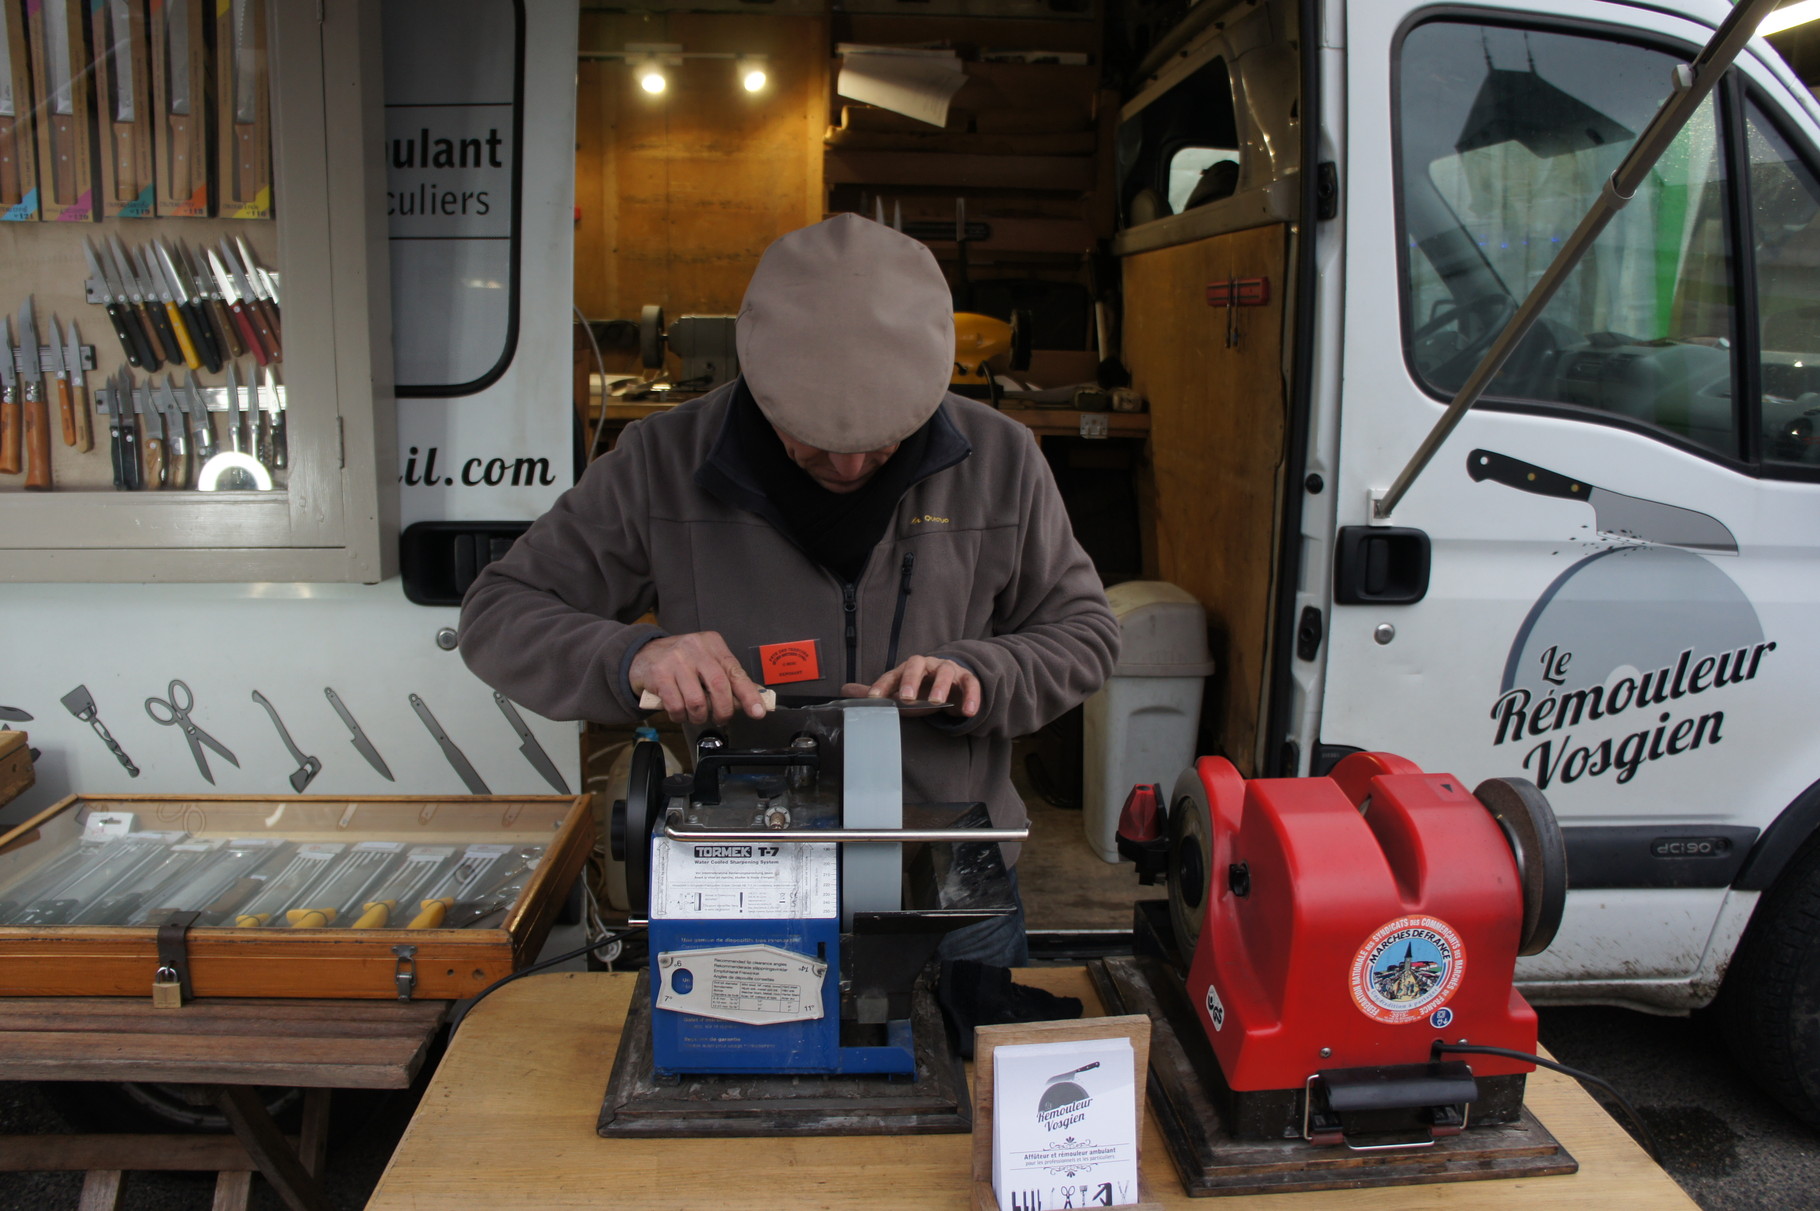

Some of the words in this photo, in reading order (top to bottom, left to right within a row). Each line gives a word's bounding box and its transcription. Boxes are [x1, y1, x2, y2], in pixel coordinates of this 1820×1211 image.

[386, 128, 502, 168] ulant
[399, 446, 556, 486] il.com
[1540, 645, 1572, 685] Le
[1490, 641, 1777, 746] Rémouleur
[1523, 711, 1724, 790] Vosgien
[695, 847, 751, 857] TORMEK
[758, 847, 779, 857] T-7
[1352, 950, 1367, 985] NATIONALE
[1372, 918, 1409, 942] SYNDICATS
[1419, 995, 1445, 1015] FRANCE
[1369, 929, 1411, 964] MARCHES
[1412, 929, 1424, 938] DE
[1424, 931, 1451, 960] FRANCE
[1044, 1113, 1085, 1132] Vosgien
